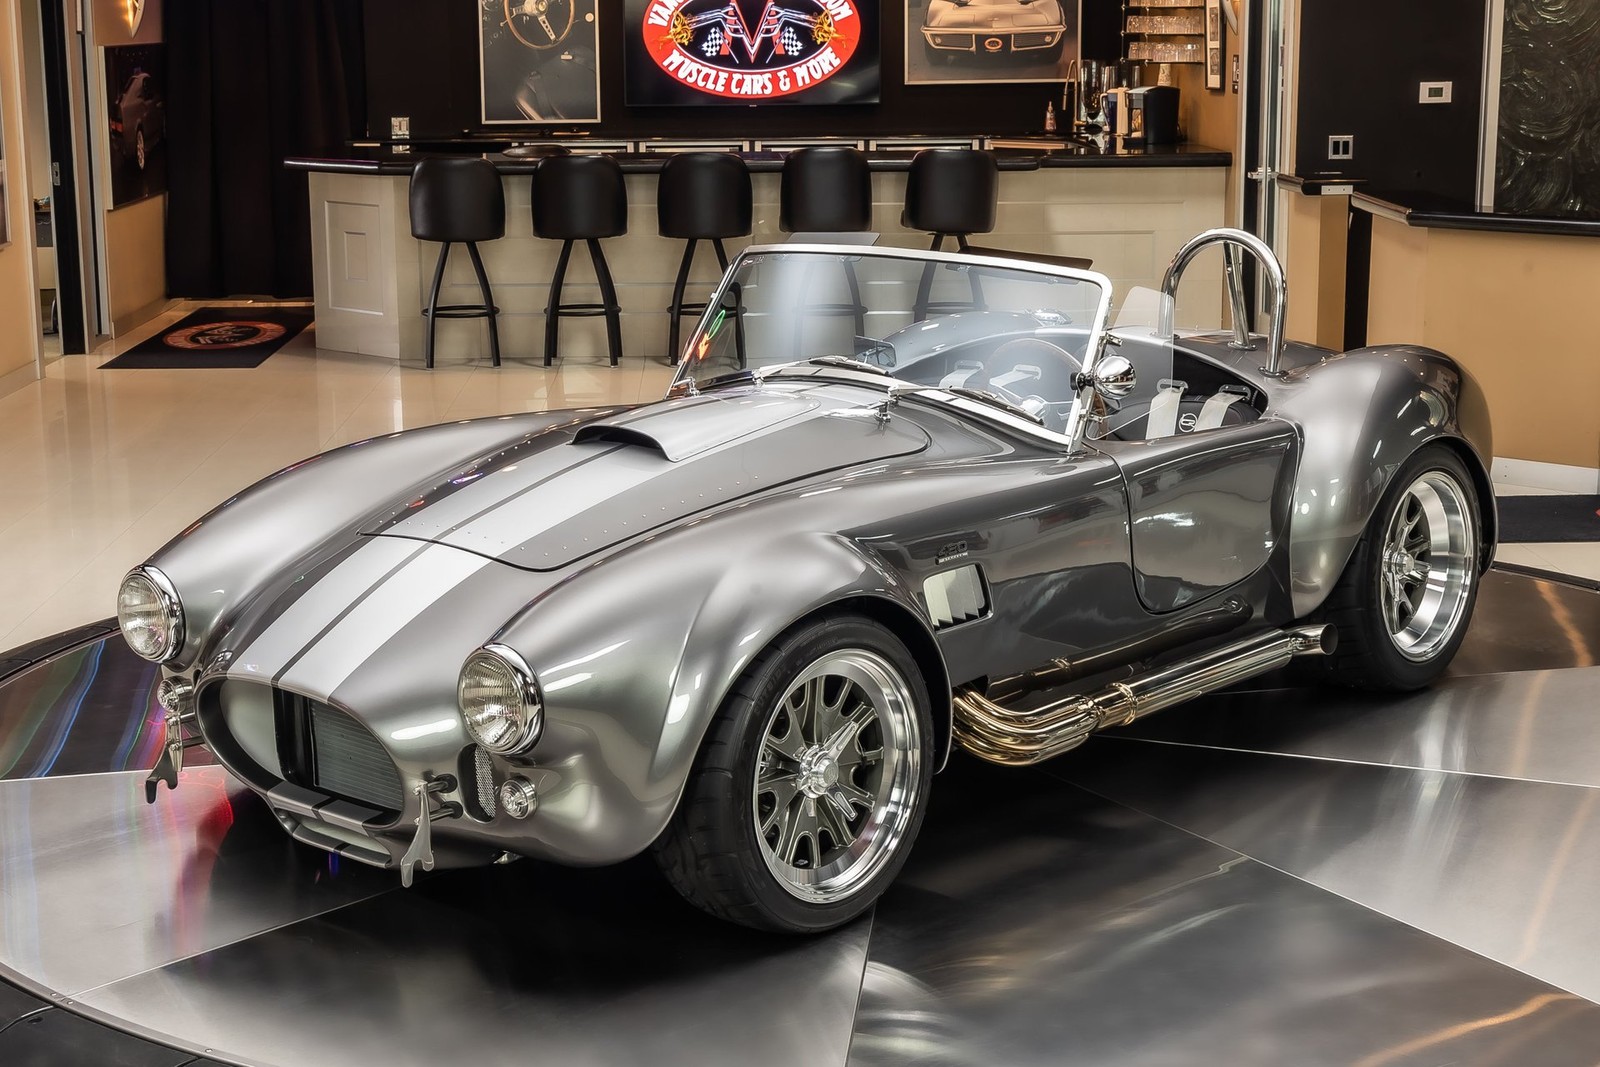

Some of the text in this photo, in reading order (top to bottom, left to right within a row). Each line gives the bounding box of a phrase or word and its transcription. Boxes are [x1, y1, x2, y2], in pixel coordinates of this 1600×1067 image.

[648, 0, 853, 26] VAN OM
[662, 46, 841, 95] MUSCLE CARS & MORE
